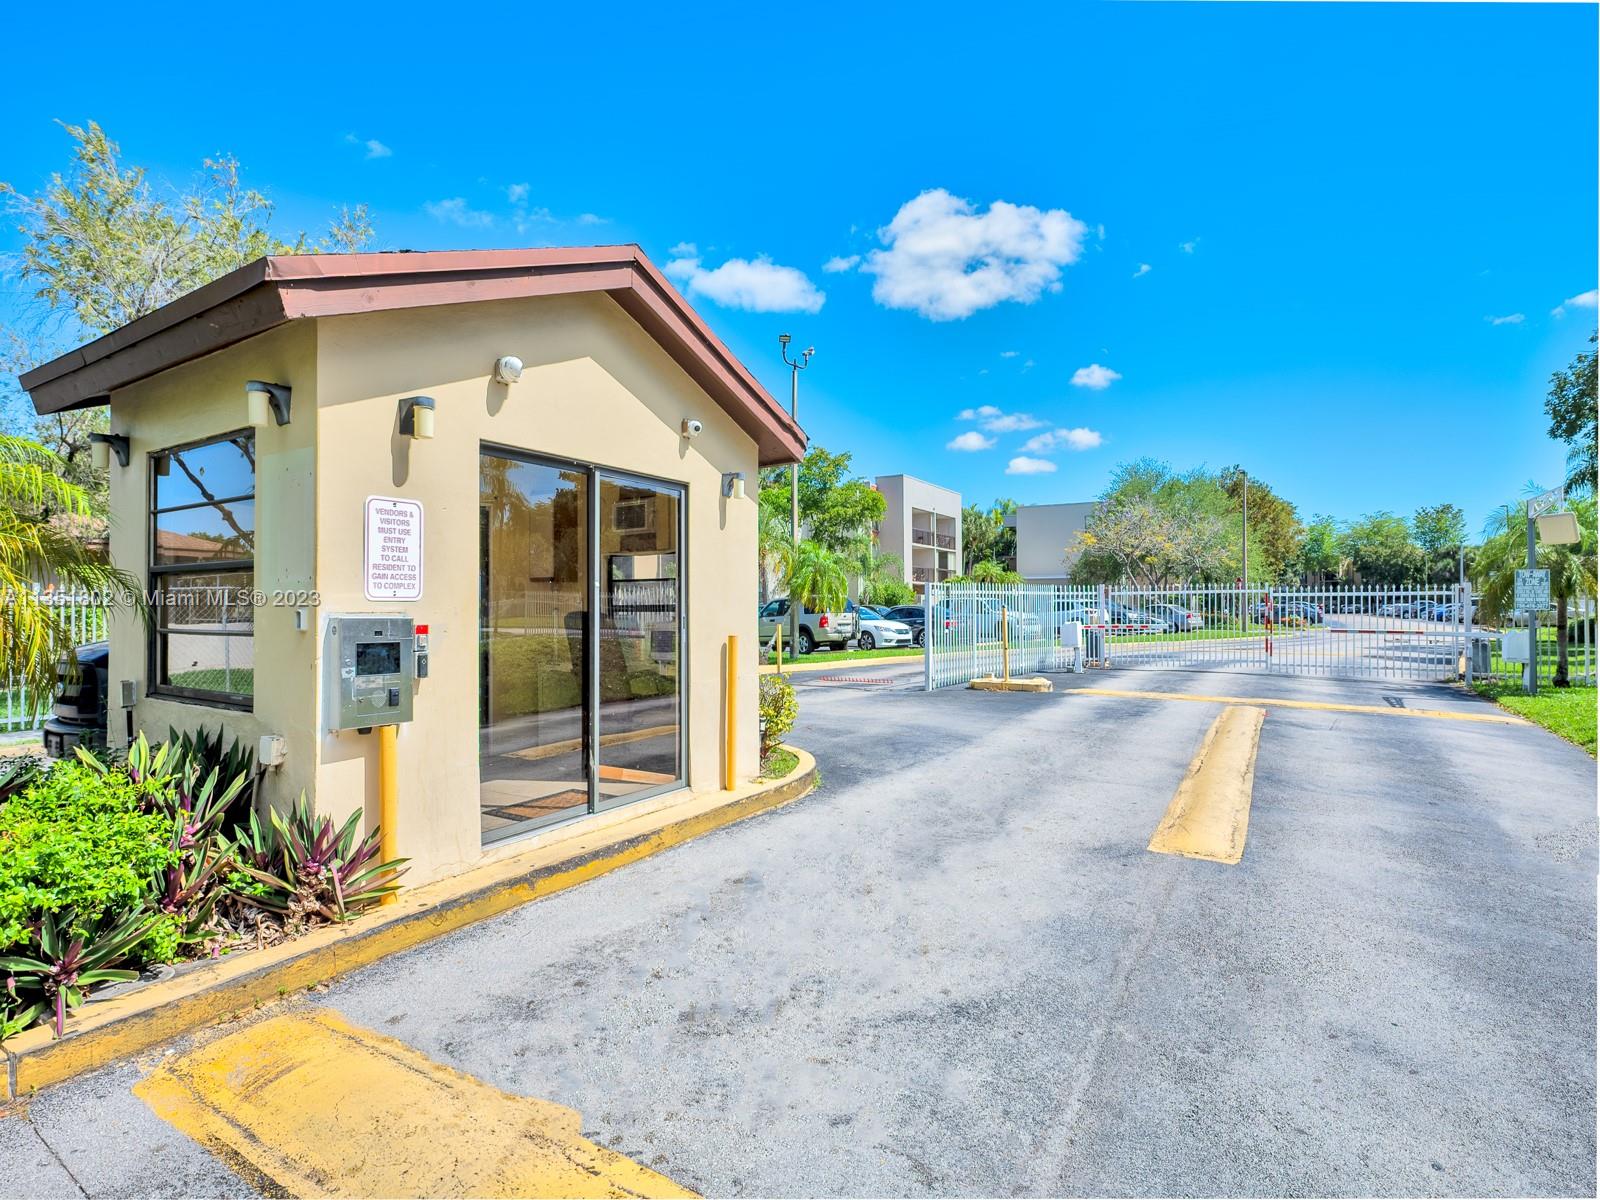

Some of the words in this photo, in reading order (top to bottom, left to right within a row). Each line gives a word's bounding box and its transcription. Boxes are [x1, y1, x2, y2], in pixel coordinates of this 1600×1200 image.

[375, 507, 408, 518] VENDORS
[379, 517, 410, 527] VISITORS
[377, 526, 397, 535] MUST
[398, 528, 412, 536] USE
[383, 536, 406, 544] ENTRY
[381, 545, 409, 553] SYSTEM
[380, 554, 390, 562] TO
[391, 554, 409, 563] CALL
[372, 563, 406, 572] RESIDENT
[407, 564, 416, 572] TO
[371, 572, 389, 580] GAIN
[389, 573, 417, 581] ACCESS
[372, 582, 382, 590] TO
[383, 582, 416, 590] COMPLEX
[1524, 577, 1541, 586] ZONE
